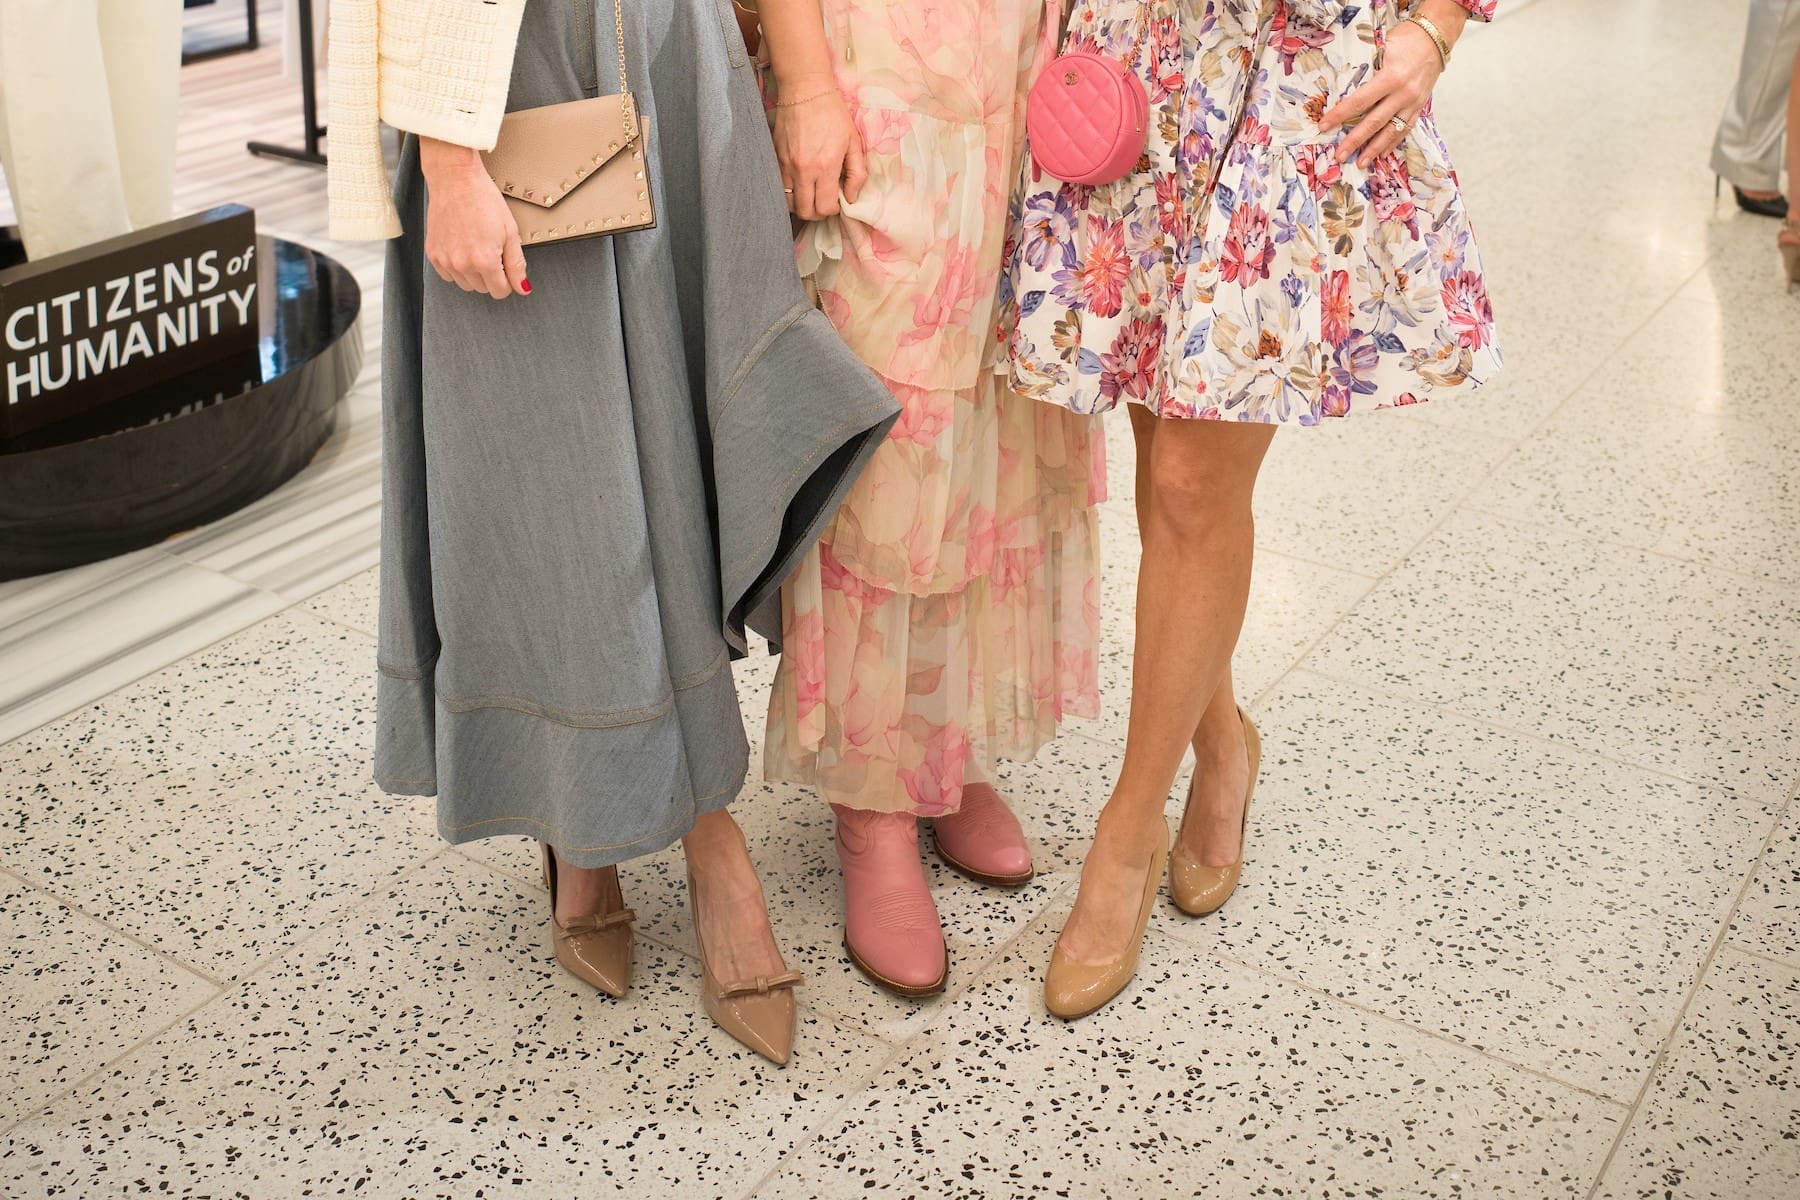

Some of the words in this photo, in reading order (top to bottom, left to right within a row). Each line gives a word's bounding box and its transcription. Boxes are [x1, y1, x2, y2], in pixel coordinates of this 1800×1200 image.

[5, 250, 219, 350] CITIZENS
[226, 246, 254, 276] of
[7, 283, 256, 405] HUMANITY
